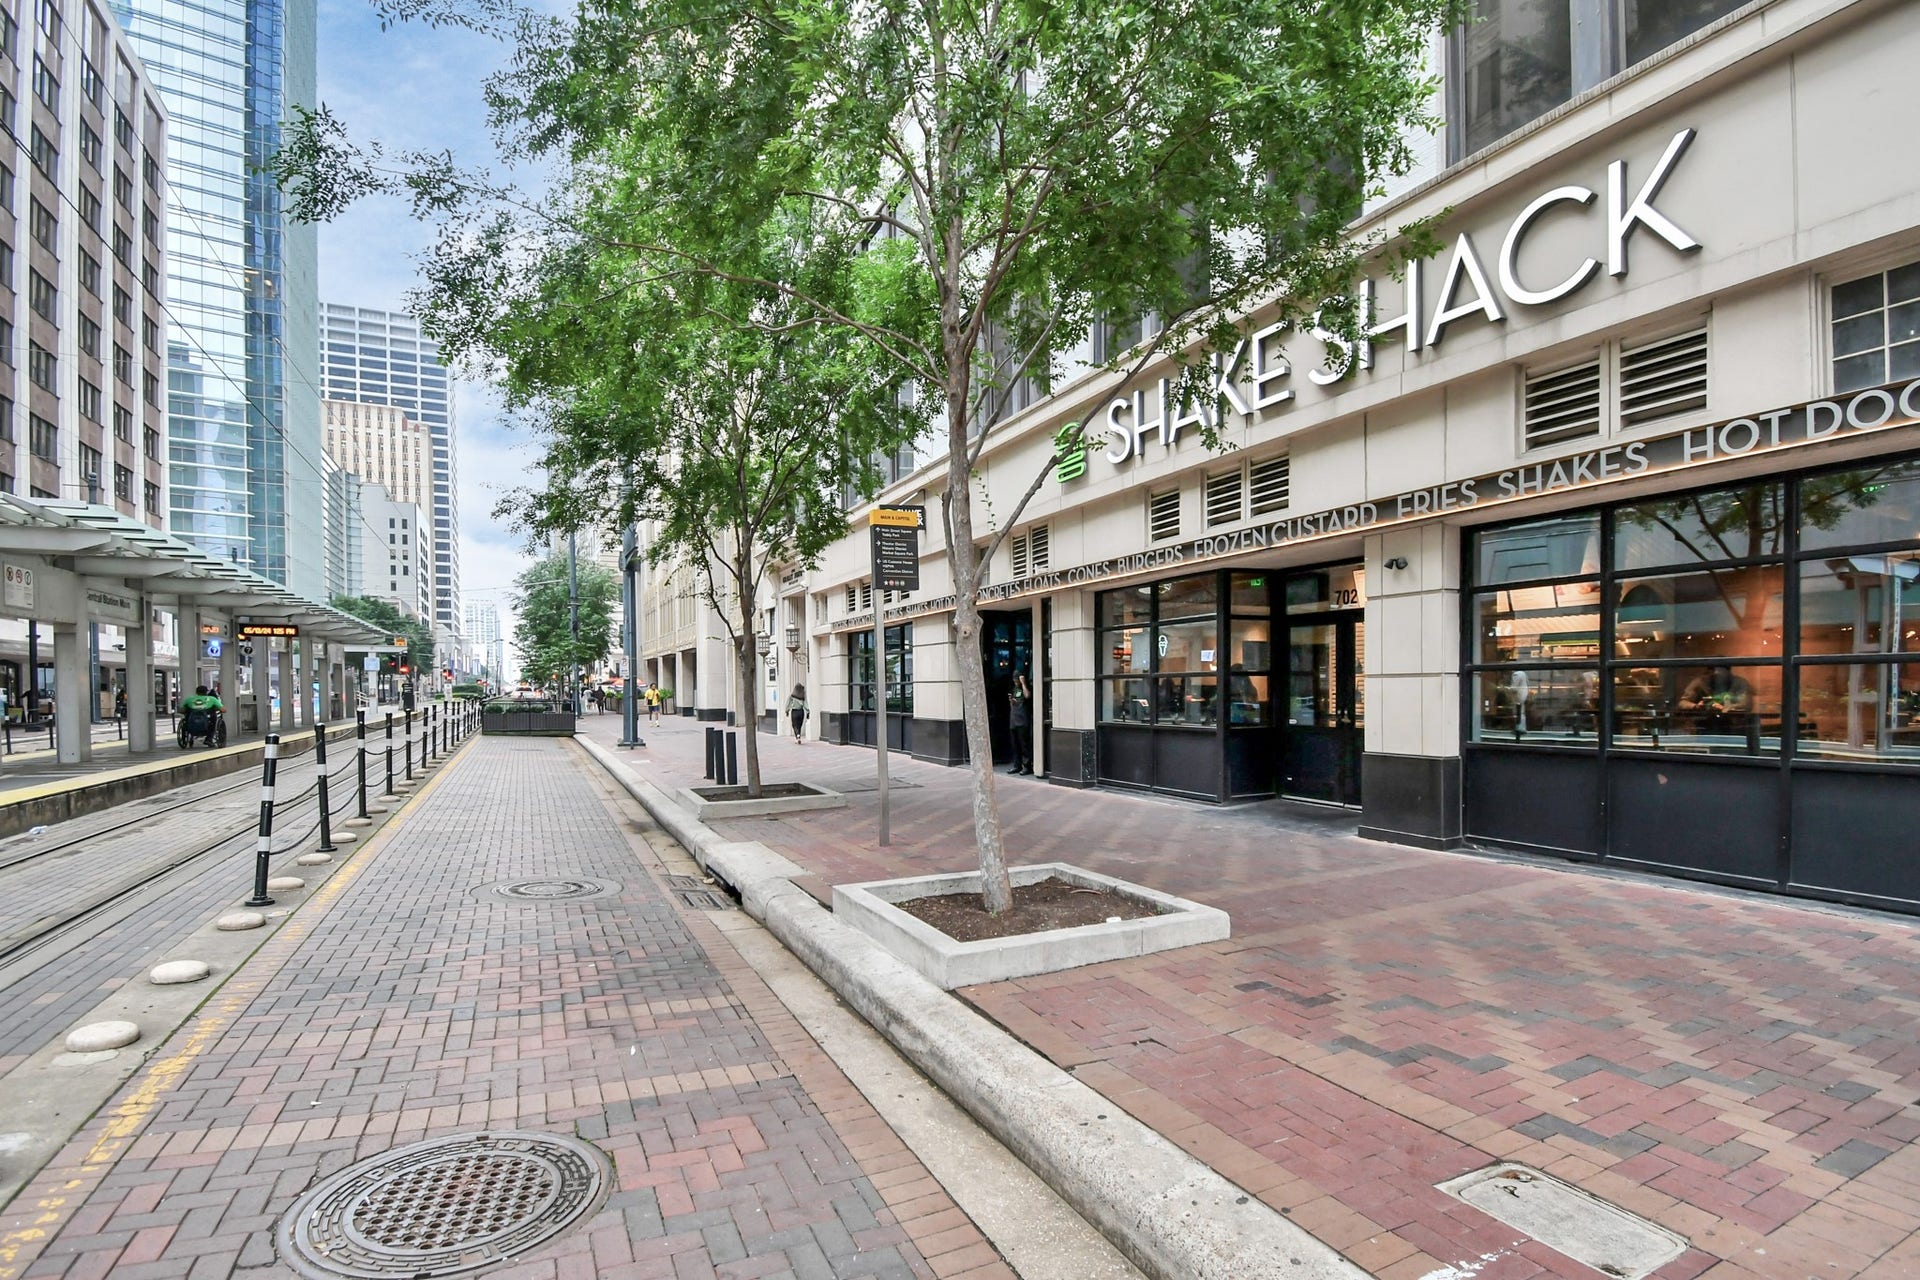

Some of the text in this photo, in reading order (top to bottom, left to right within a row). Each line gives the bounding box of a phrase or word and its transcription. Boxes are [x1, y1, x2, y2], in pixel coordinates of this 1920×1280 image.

[1106, 128, 1702, 465] SHAKE SHACK
[977, 581, 1021, 601] ONCRETES
[1024, 572, 1061, 592] FLOATS
[1067, 561, 1111, 584] CONES
[1117, 544, 1184, 574] BURGERS
[1194, 526, 1267, 559] FROZEN
[1271, 503, 1377, 543] CUSTARD
[1397, 479, 1478, 520] FRIES
[1497, 442, 1649, 500] SHAKES
[1683, 408, 1792, 463] HOT
[1335, 589, 1358, 605] 702
